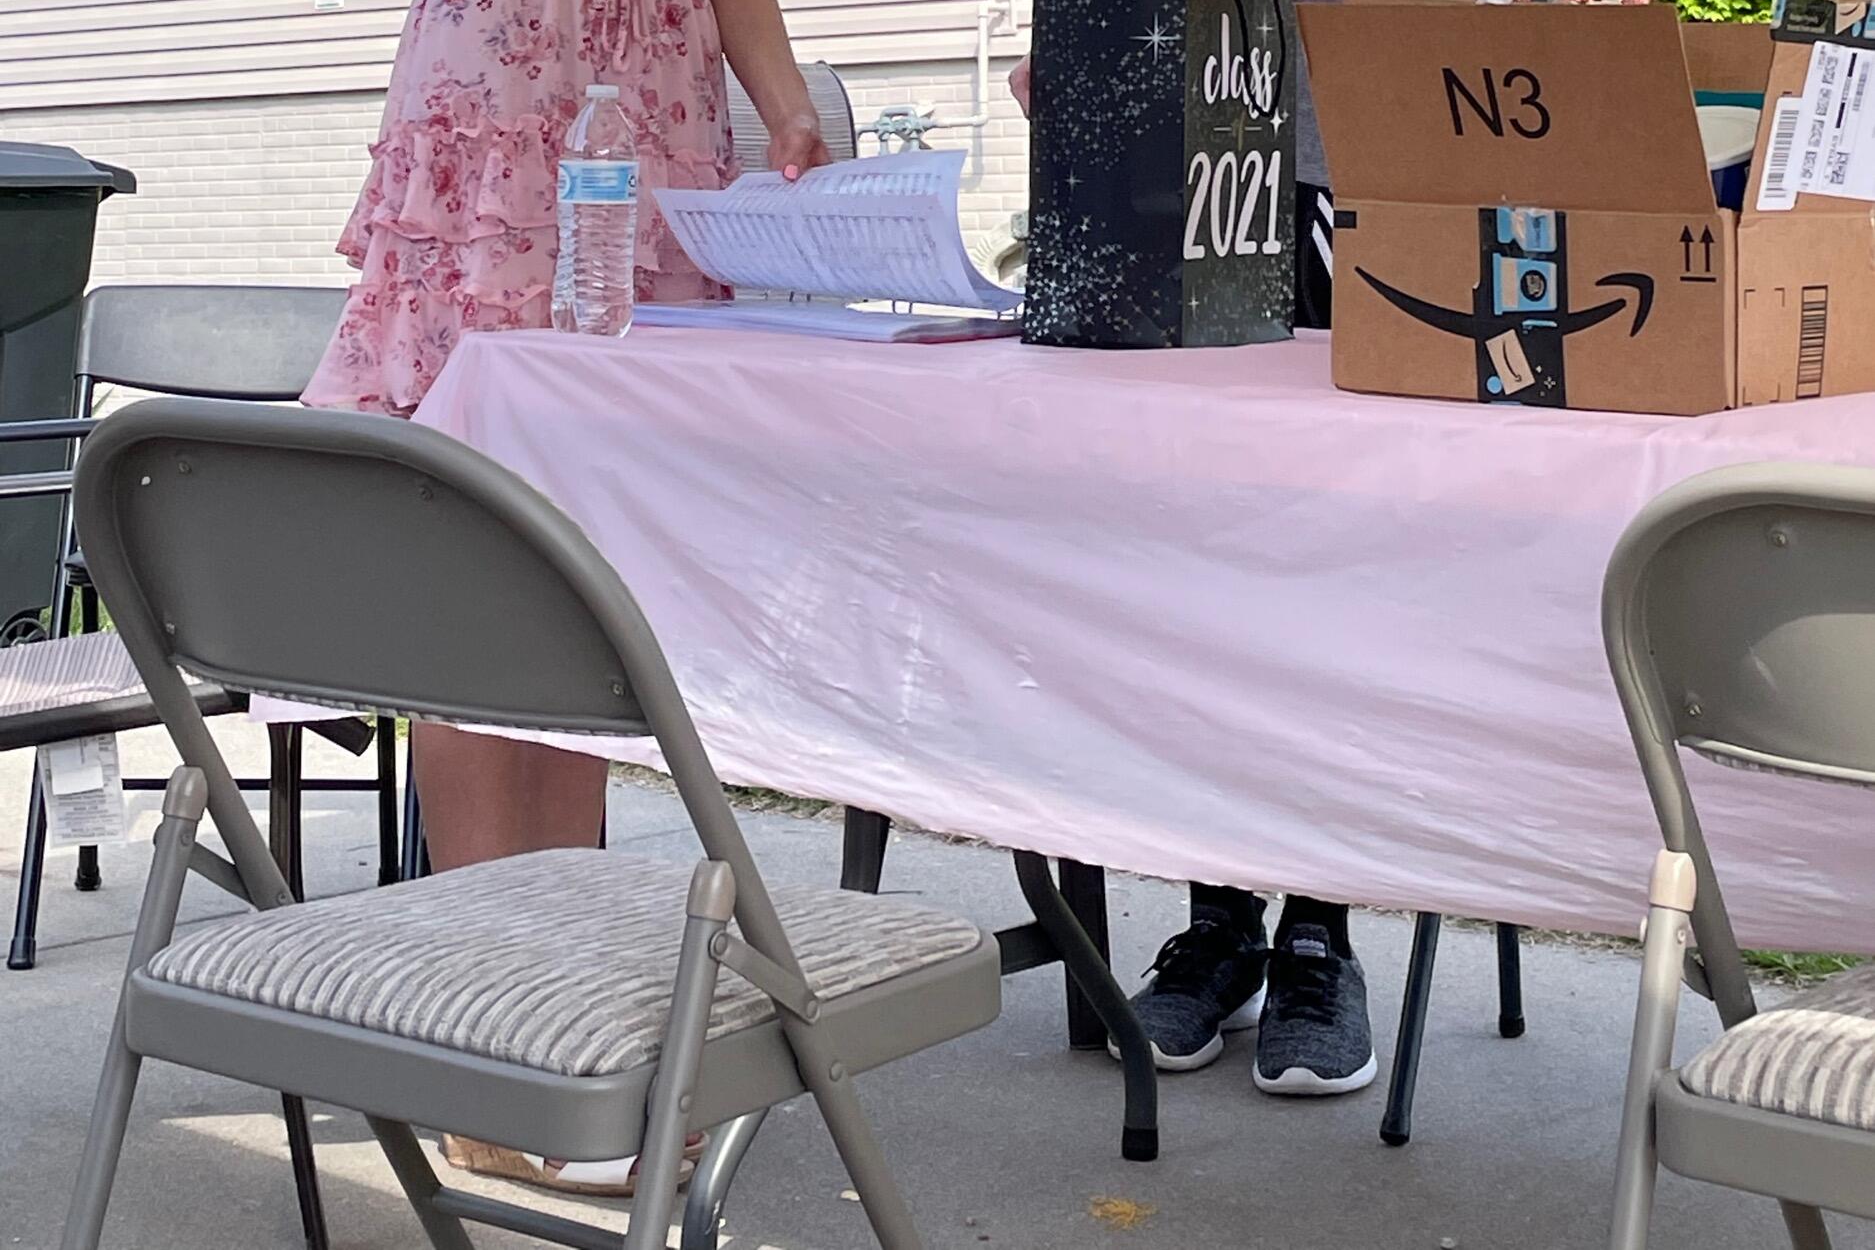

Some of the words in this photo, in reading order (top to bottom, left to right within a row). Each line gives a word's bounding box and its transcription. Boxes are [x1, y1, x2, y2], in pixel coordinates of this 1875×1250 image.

[1203, 13, 1278, 119] class
[1441, 67, 1551, 139] N3
[1183, 150, 1282, 260] 2021
